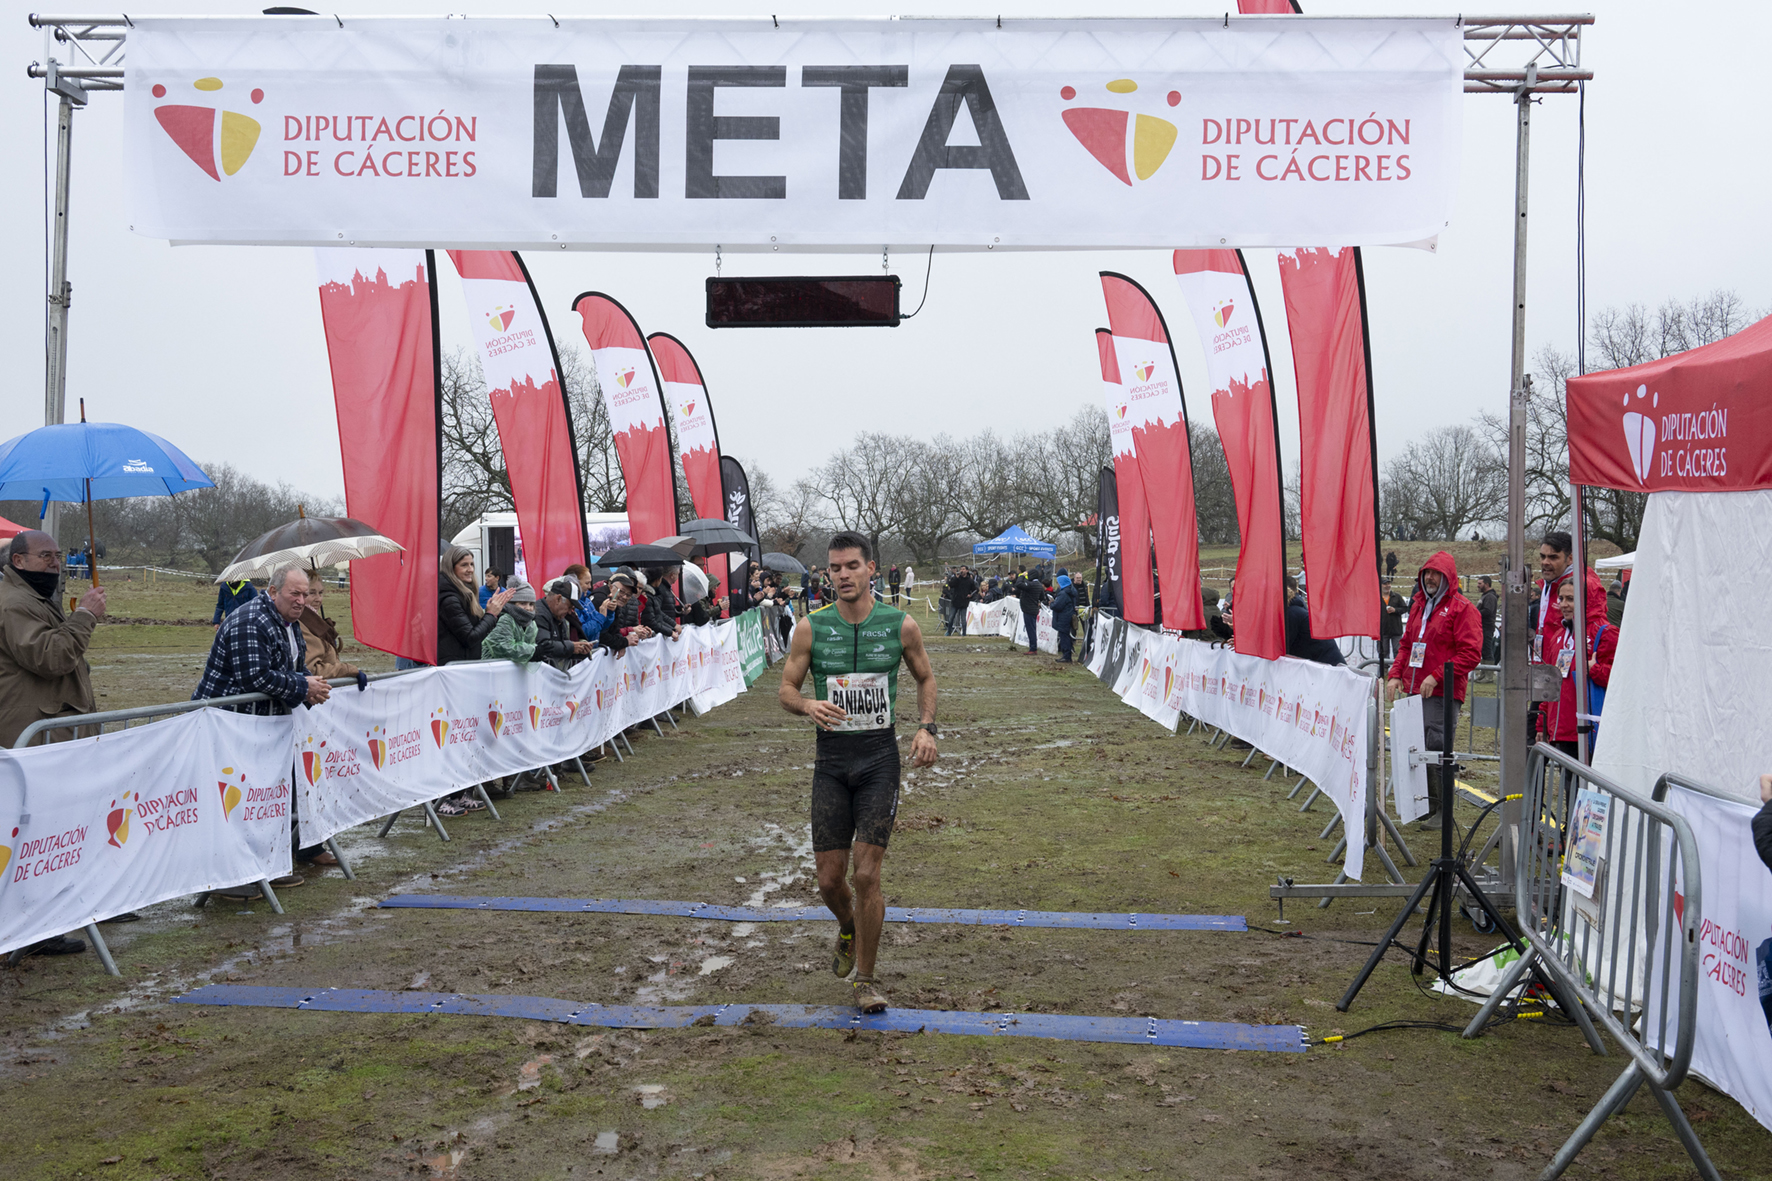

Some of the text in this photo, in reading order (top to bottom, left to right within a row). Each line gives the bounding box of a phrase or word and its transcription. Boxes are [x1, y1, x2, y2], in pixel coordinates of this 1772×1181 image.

[283, 108, 477, 142] DIPUTACIÓN
[533, 64, 1030, 200] META
[1202, 111, 1411, 146] DIPUTACIÓN
[283, 144, 477, 178] DE CÁCERES
[1201, 148, 1412, 182] DE CÁCERES
[1661, 402, 1728, 443] DIPUTACIÓN
[1660, 442, 1727, 478] DE CÁCERES
[833, 687, 888, 715] PANIAGUA
[875, 714, 885, 725] 6
[388, 727, 421, 750] DIPUTACIÓN
[389, 744, 421, 765] DE CÁCERES
[243, 806, 256, 821] DE
[19, 823, 89, 860] DIPUTACIÓN
[14, 846, 83, 883] DE CÁCERES
[1699, 918, 1750, 964] IPUTACIÓN
